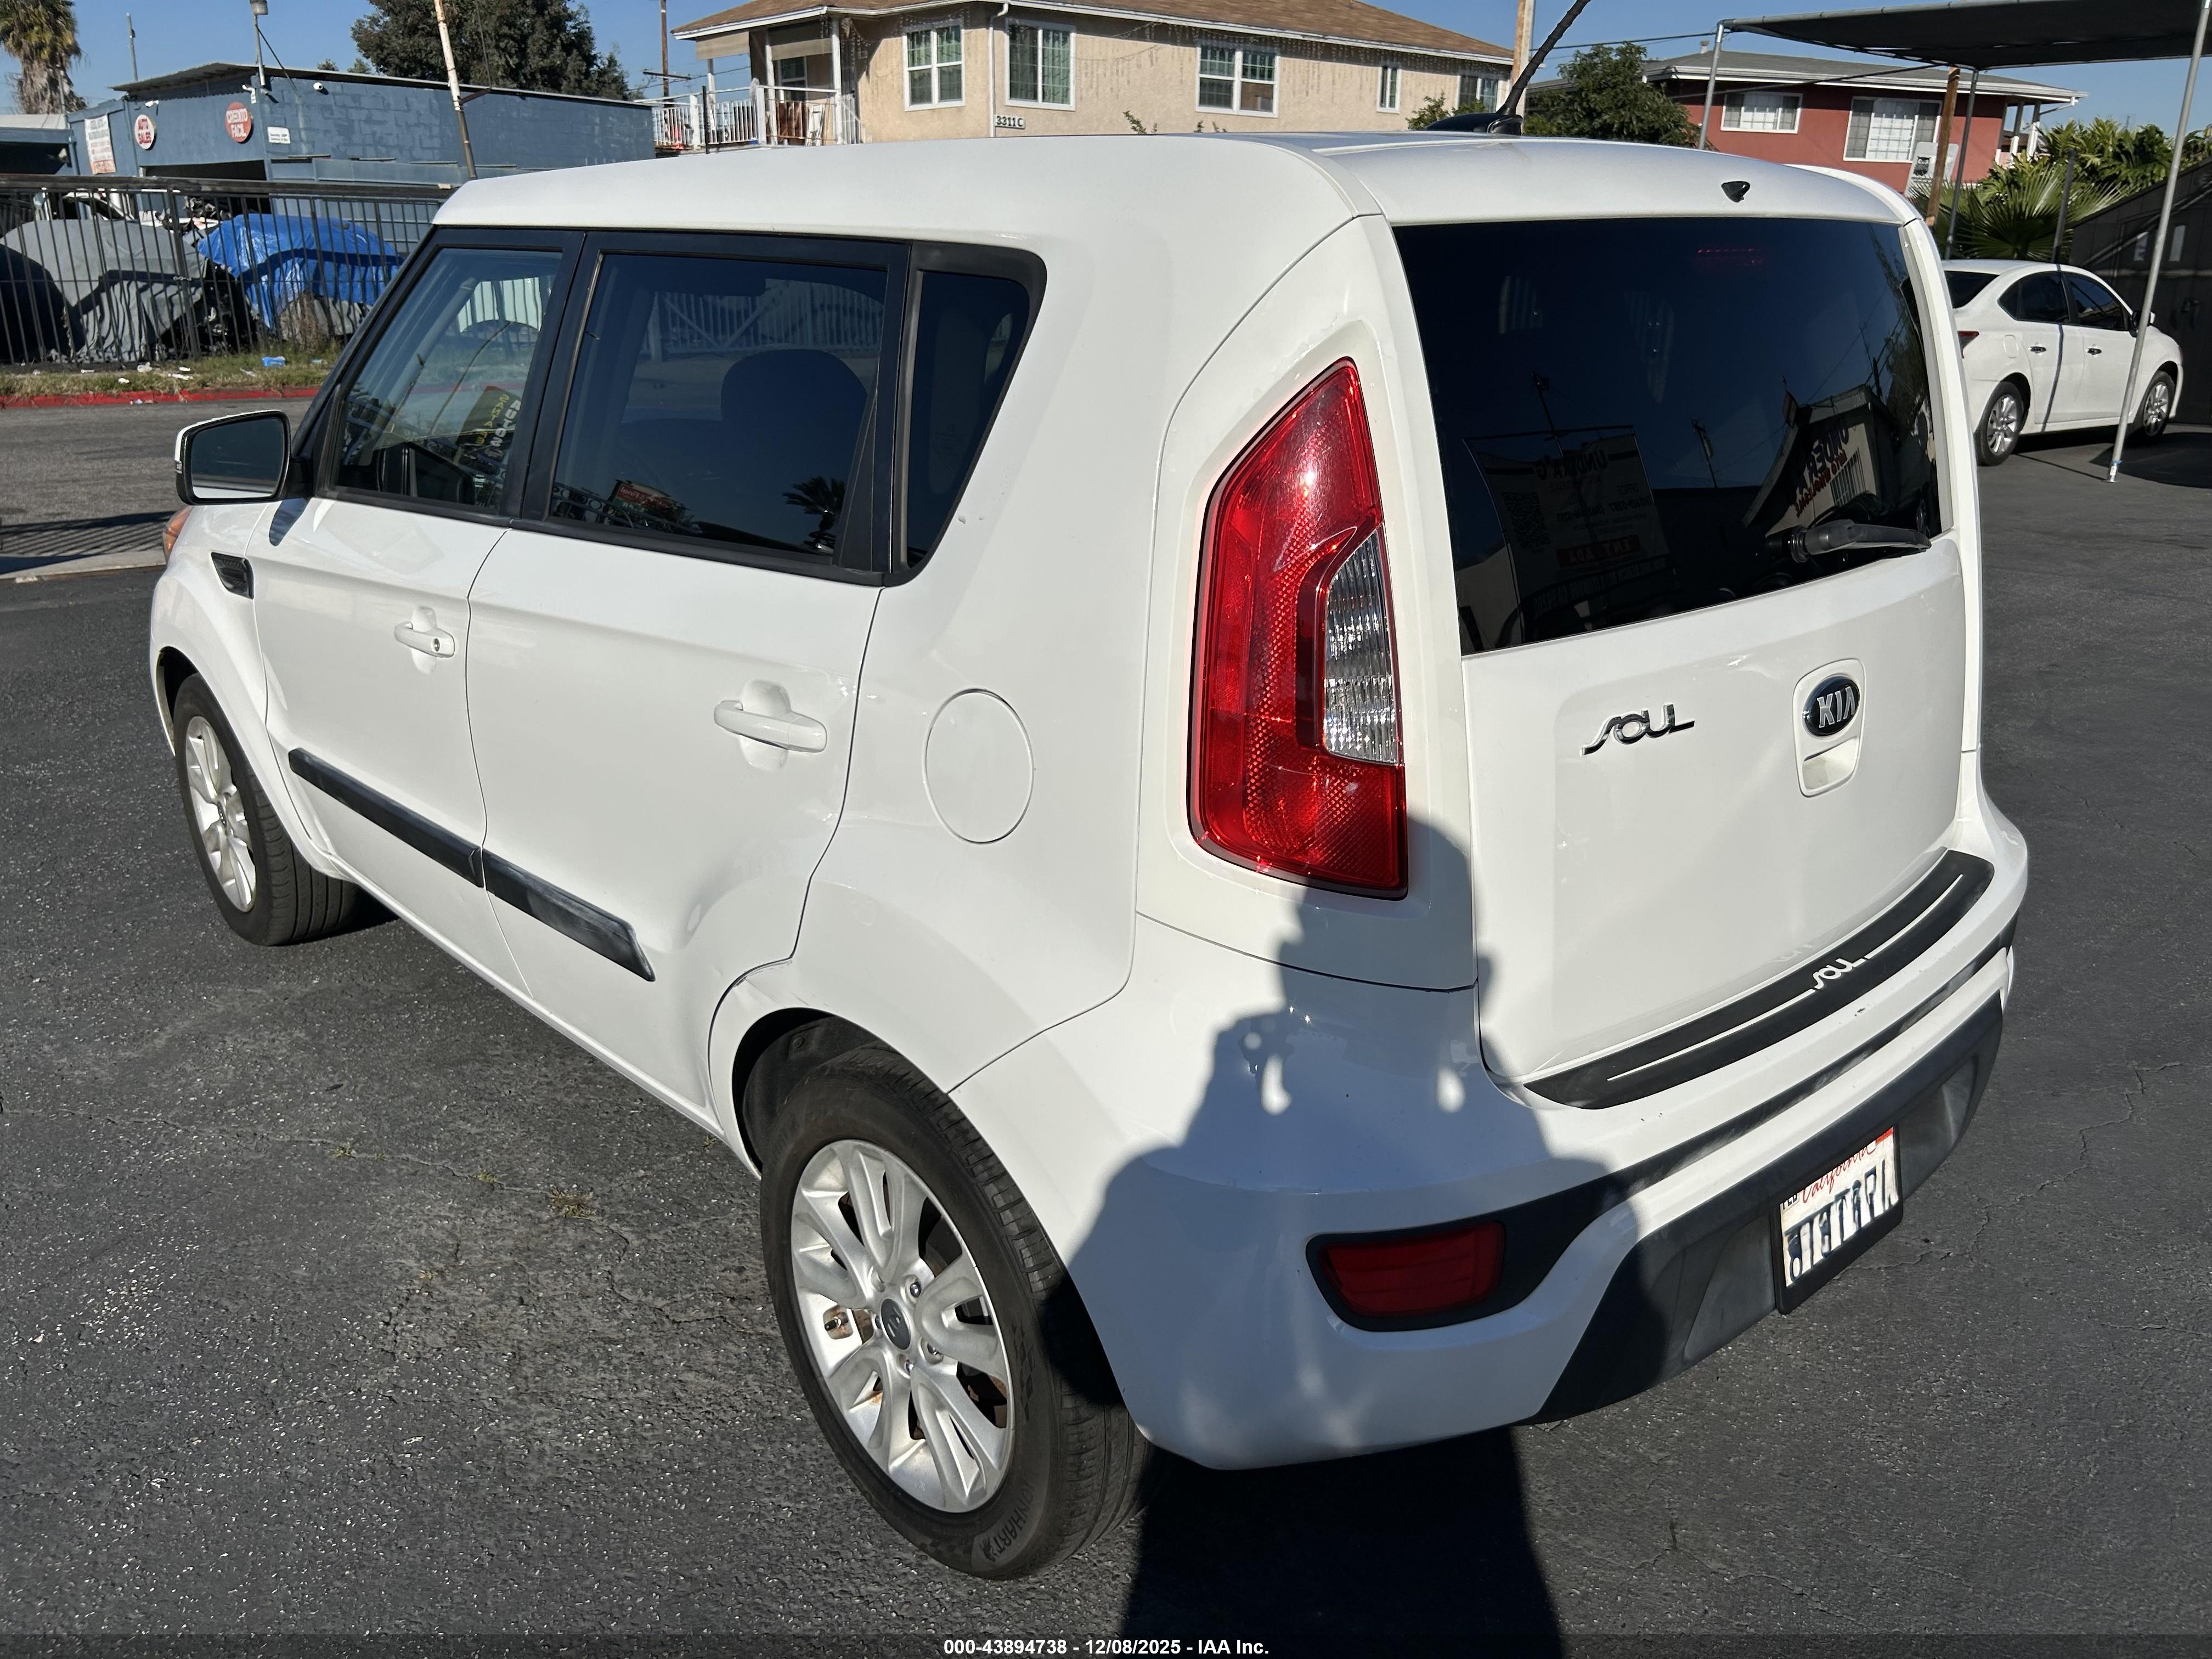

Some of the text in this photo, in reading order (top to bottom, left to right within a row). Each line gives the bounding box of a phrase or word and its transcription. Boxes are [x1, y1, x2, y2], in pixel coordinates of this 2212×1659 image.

[1581, 703, 1695, 756] SOUL
[1817, 686, 1856, 729] KIA
[1813, 958, 1866, 990] SOUL
[1802, 1146, 1876, 1204] California
